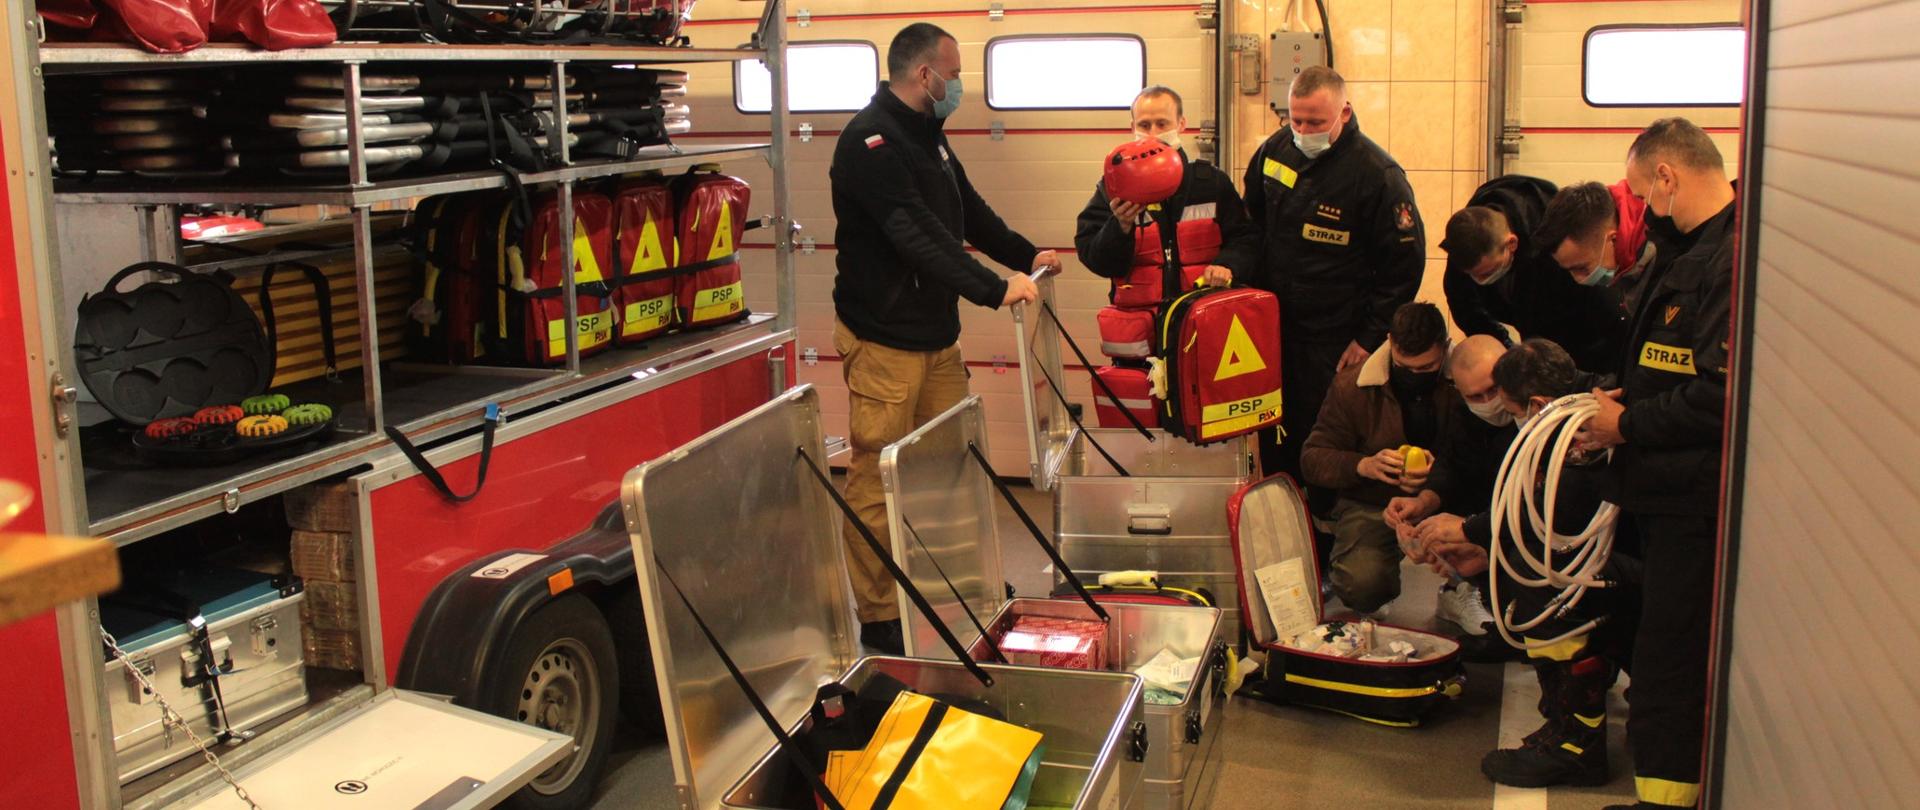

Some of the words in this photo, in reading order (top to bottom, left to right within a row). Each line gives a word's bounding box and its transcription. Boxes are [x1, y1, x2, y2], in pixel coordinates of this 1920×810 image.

[712, 287, 733, 303] PSP
[640, 299, 663, 316] PSP
[576, 316, 600, 332] SP
[1228, 398, 1263, 416] PSP
[1258, 409, 1277, 422] PAX
